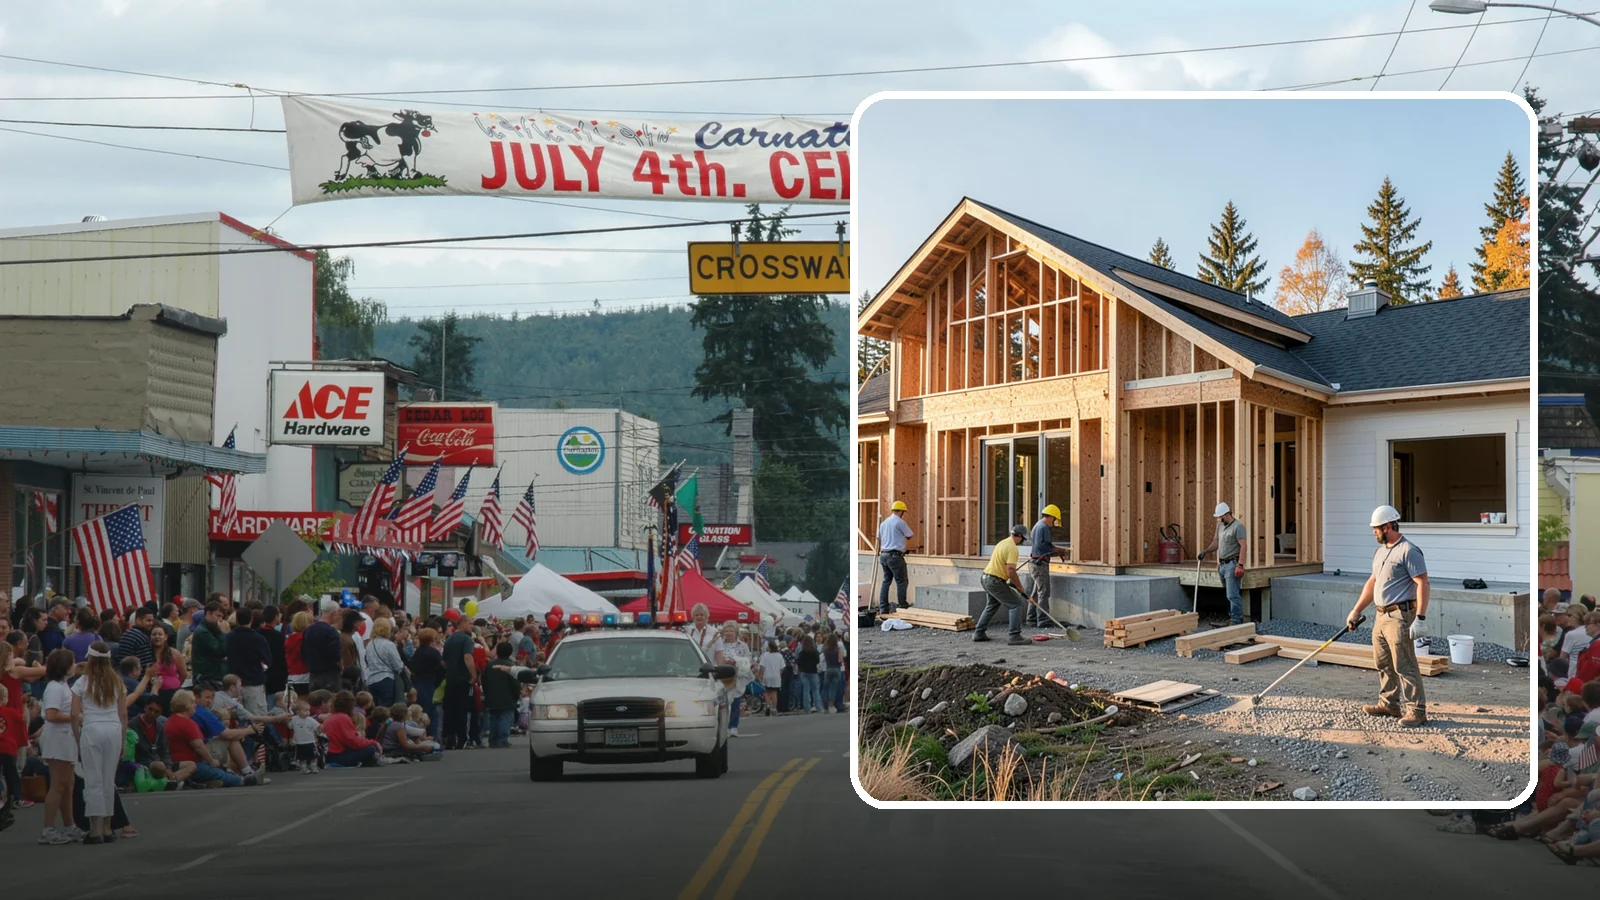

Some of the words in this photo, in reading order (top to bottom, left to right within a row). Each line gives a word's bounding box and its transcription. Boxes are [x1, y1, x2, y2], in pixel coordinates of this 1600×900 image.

[481, 141, 605, 192] JULY
[632, 150, 746, 197] 4th.
[697, 254, 850, 280] CROSSWA
[283, 380, 373, 420] ACE
[405, 409, 452, 422] CEDAR
[283, 421, 371, 437] Hardware
[96, 485, 124, 495] Vincent
[126, 486, 136, 495] de
[137, 486, 155, 495] Paul
[688, 526, 741, 535] CRNATION
